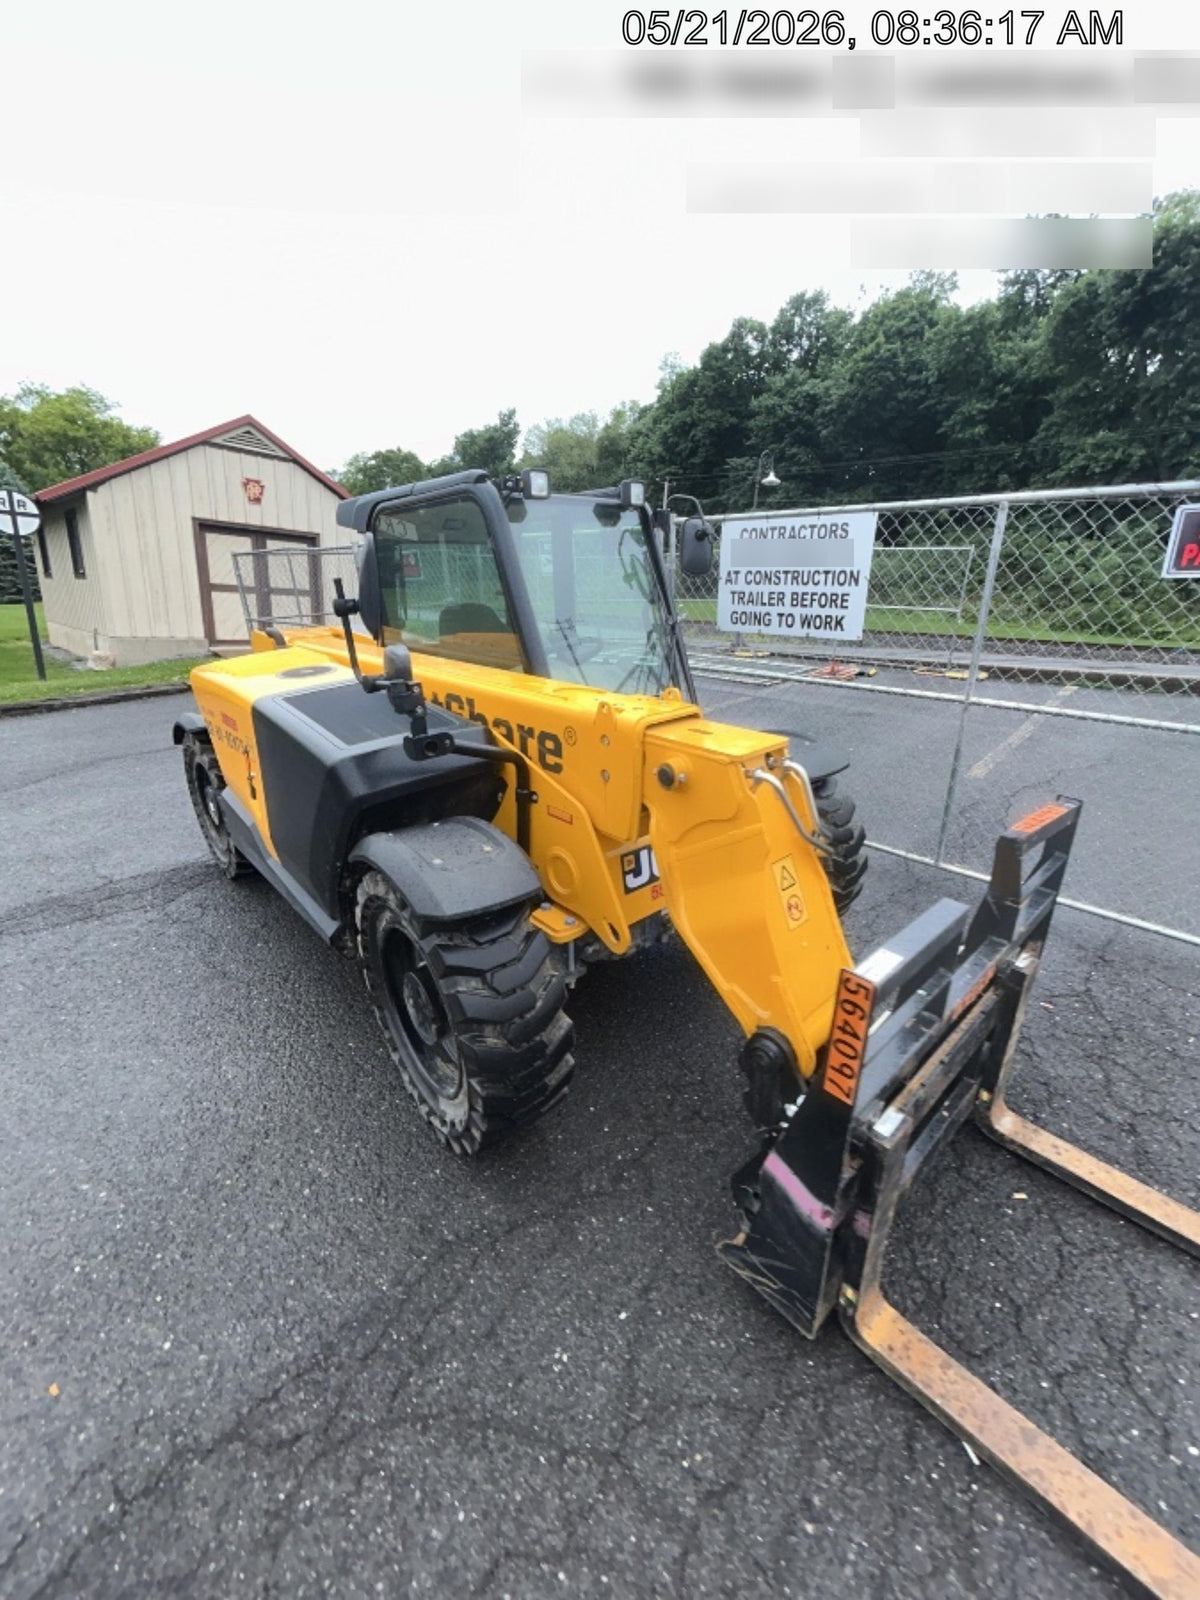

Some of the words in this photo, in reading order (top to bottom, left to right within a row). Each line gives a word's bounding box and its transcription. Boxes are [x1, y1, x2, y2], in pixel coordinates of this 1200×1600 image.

[16, 498, 28, 511] R
[740, 522, 850, 540] CONTRACTORS
[1180, 543, 1200, 567] P
[725, 570, 741, 586] AT
[744, 570, 861, 587] CONSTRUCTION
[730, 591, 786, 607] TRAILER
[790, 592, 850, 609] BEFORE
[730, 611, 772, 627] GOING
[777, 613, 796, 628] TO
[800, 614, 846, 631] WORK
[828, 976, 871, 1100] 564097
